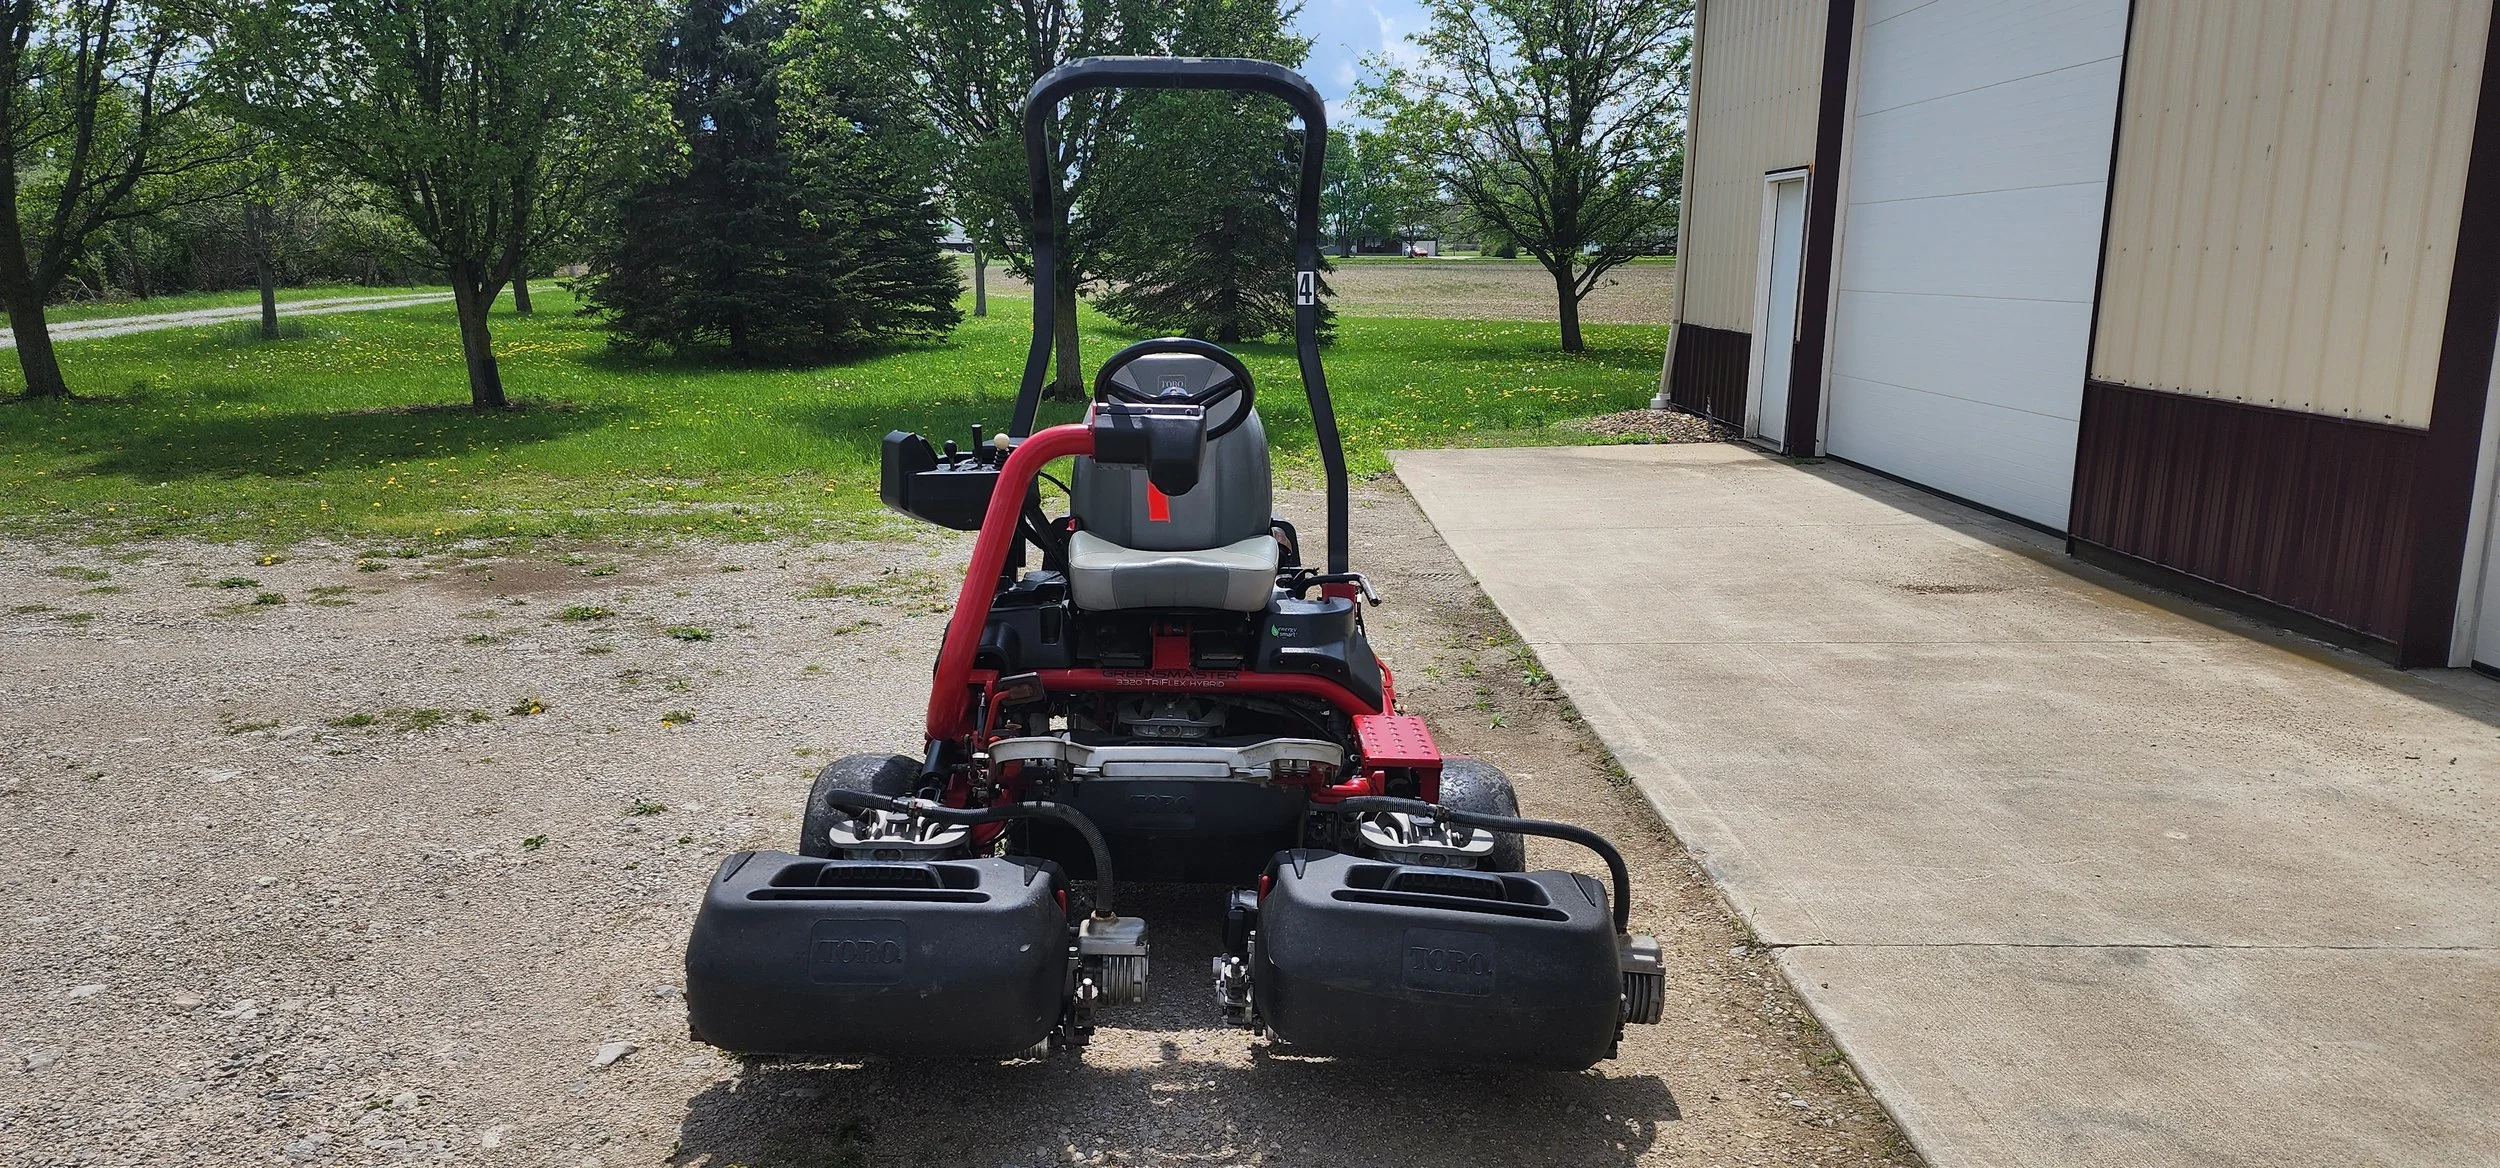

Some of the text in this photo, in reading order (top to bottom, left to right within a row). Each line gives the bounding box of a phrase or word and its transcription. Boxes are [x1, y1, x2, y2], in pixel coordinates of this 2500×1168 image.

[1299, 273, 1312, 304] 4
[1161, 380, 1184, 388] TORO
[1102, 670, 1238, 680] GREENSMASTER
[1189, 680, 1225, 688] HYBRID
